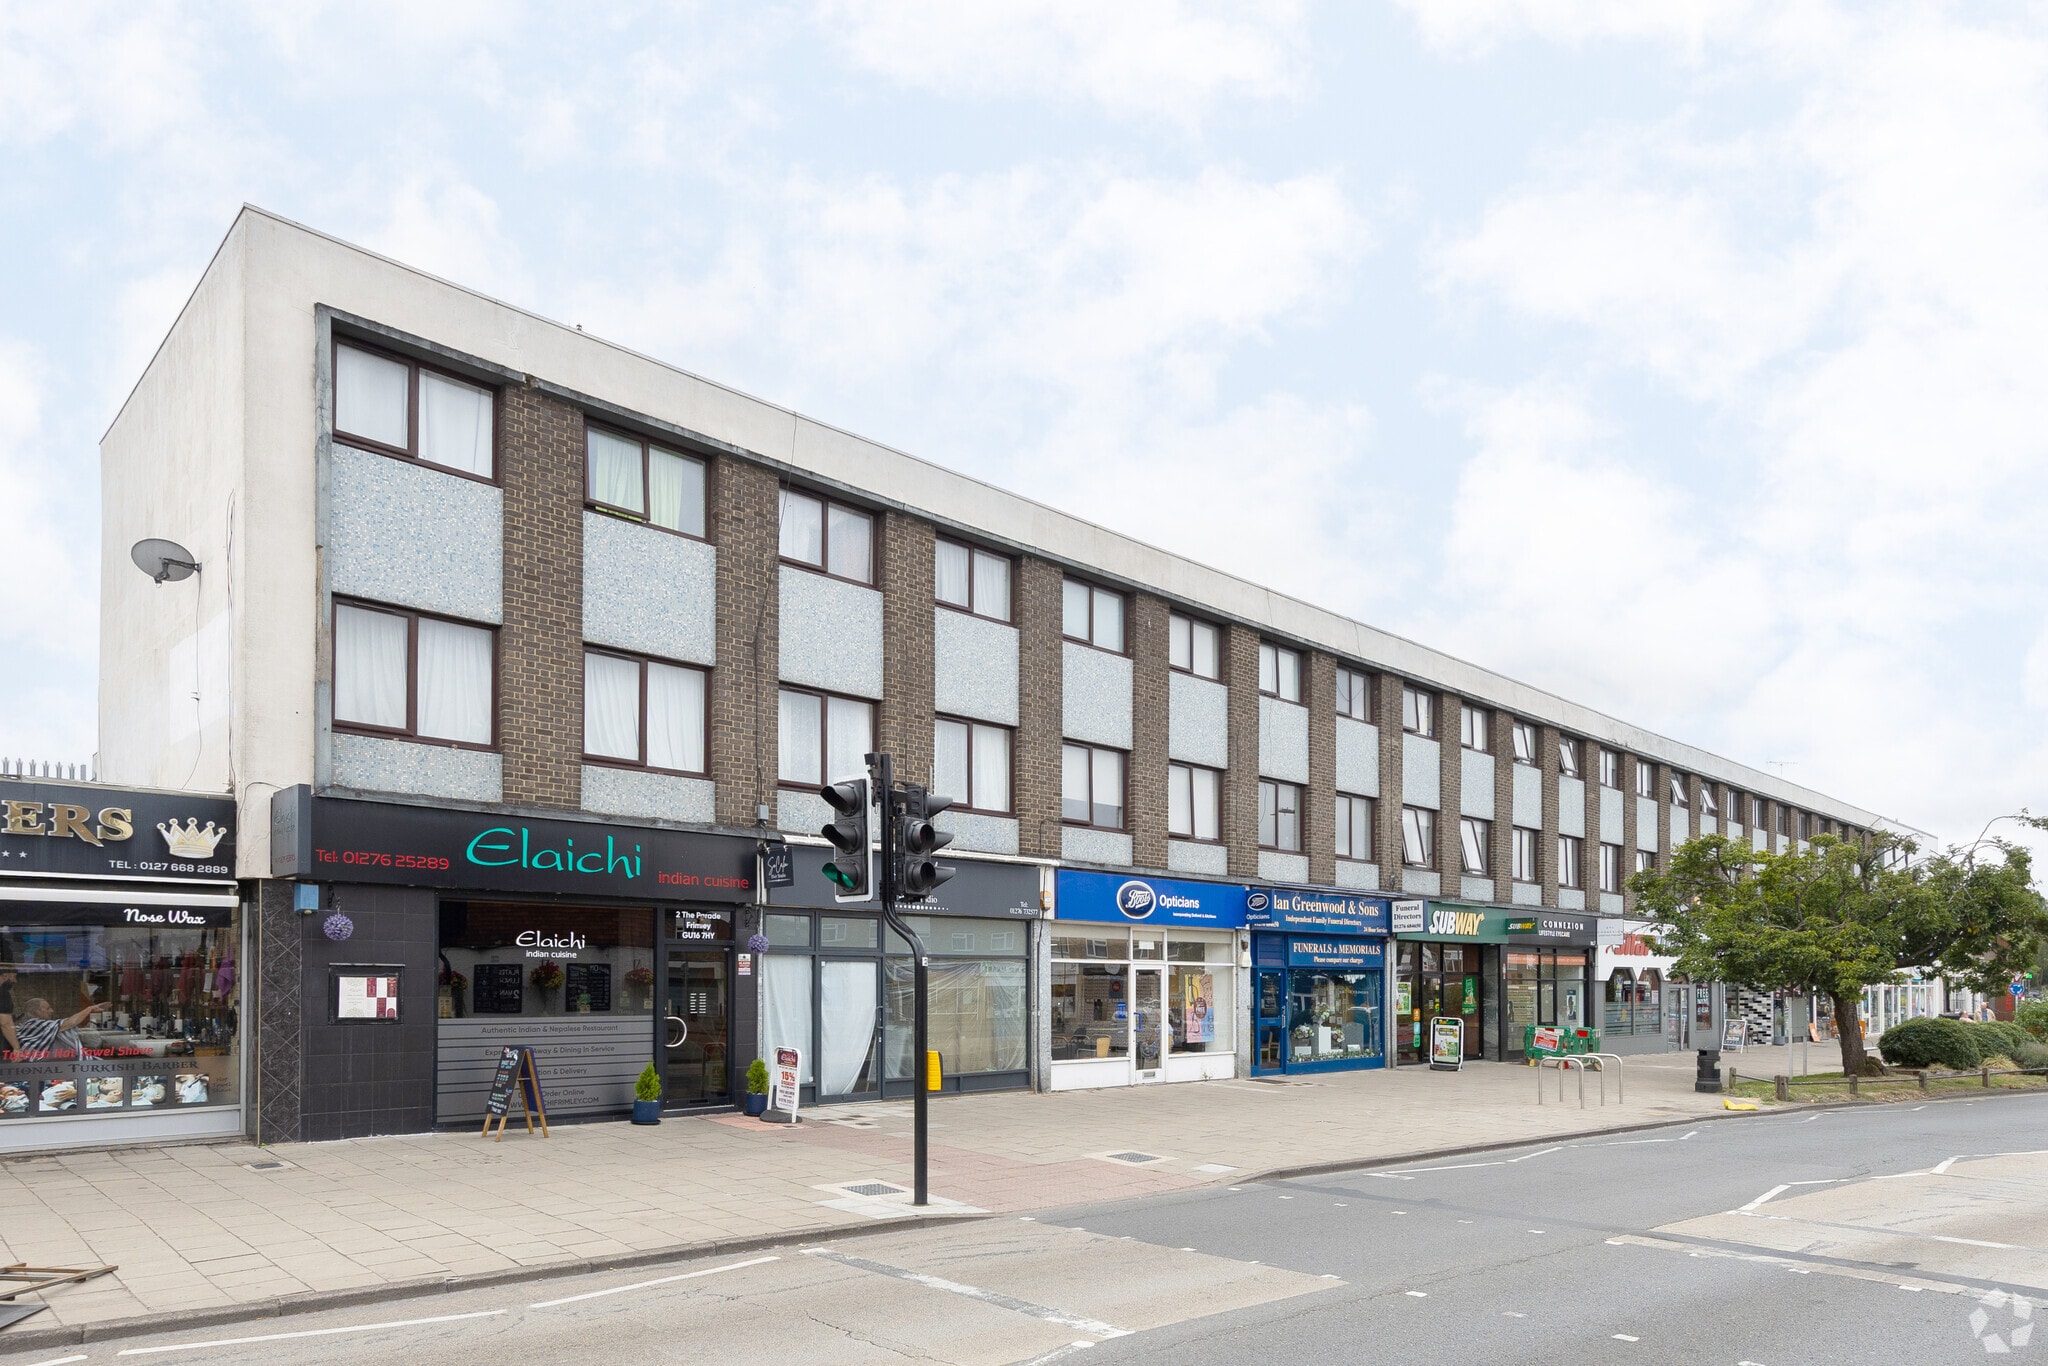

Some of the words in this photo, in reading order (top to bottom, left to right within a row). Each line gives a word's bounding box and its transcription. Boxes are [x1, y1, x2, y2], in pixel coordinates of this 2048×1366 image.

[1, 800, 134, 847] ERS
[316, 849, 338, 863] Tel:
[343, 851, 392, 867] 01276
[395, 854, 449, 870] 25289
[465, 827, 642, 879] Elaichi
[140, 861, 167, 871] 0127
[170, 863, 195, 872] 668
[197, 864, 229, 873] 2889
[658, 870, 700, 887] indian
[704, 875, 750, 889] cuisine
[1125, 889, 1151, 909] Boots
[1159, 894, 1200, 909] Opticians
[1273, 894, 1290, 910] Ian
[1291, 896, 1346, 914] Greenwood
[1347, 900, 1356, 915] &
[1358, 901, 1379, 917] Sons
[1395, 903, 1420, 911] Funeral
[124, 908, 165, 924] Nose
[168, 910, 206, 925] Wax
[1285, 914, 1312, 924] Independent
[1312, 917, 1327, 926] Family
[1327, 917, 1344, 925] Funeral
[1428, 910, 1485, 936] SUBWAY
[1507, 922, 1535, 930] SUBWAY
[1543, 920, 1584, 931] CONNEXION
[515, 930, 586, 949] Elaichi
[526, 950, 549, 958] indian
[1293, 942, 1332, 954] FUNERALS
[1338, 944, 1381, 955] MEMORIALS
[481, 1026, 517, 1034] Authentic
[518, 1025, 541, 1033] Indian
[549, 1025, 582, 1034] Nepalese
[583, 1024, 618, 1032] Restaurant
[3, 1048, 50, 1060] Turkish
[54, 1048, 76, 1058] Hot
[81, 1046, 115, 1057] Towel
[118, 1045, 154, 1056] Shave
[559, 1046, 582, 1054] Dining
[591, 1045, 615, 1053] Service
[68, 1062, 135, 1074] TURKISH
[142, 1060, 198, 1070] BARBER
[559, 1067, 587, 1076] Delivery
[781, 1071, 795, 1082] 15%
